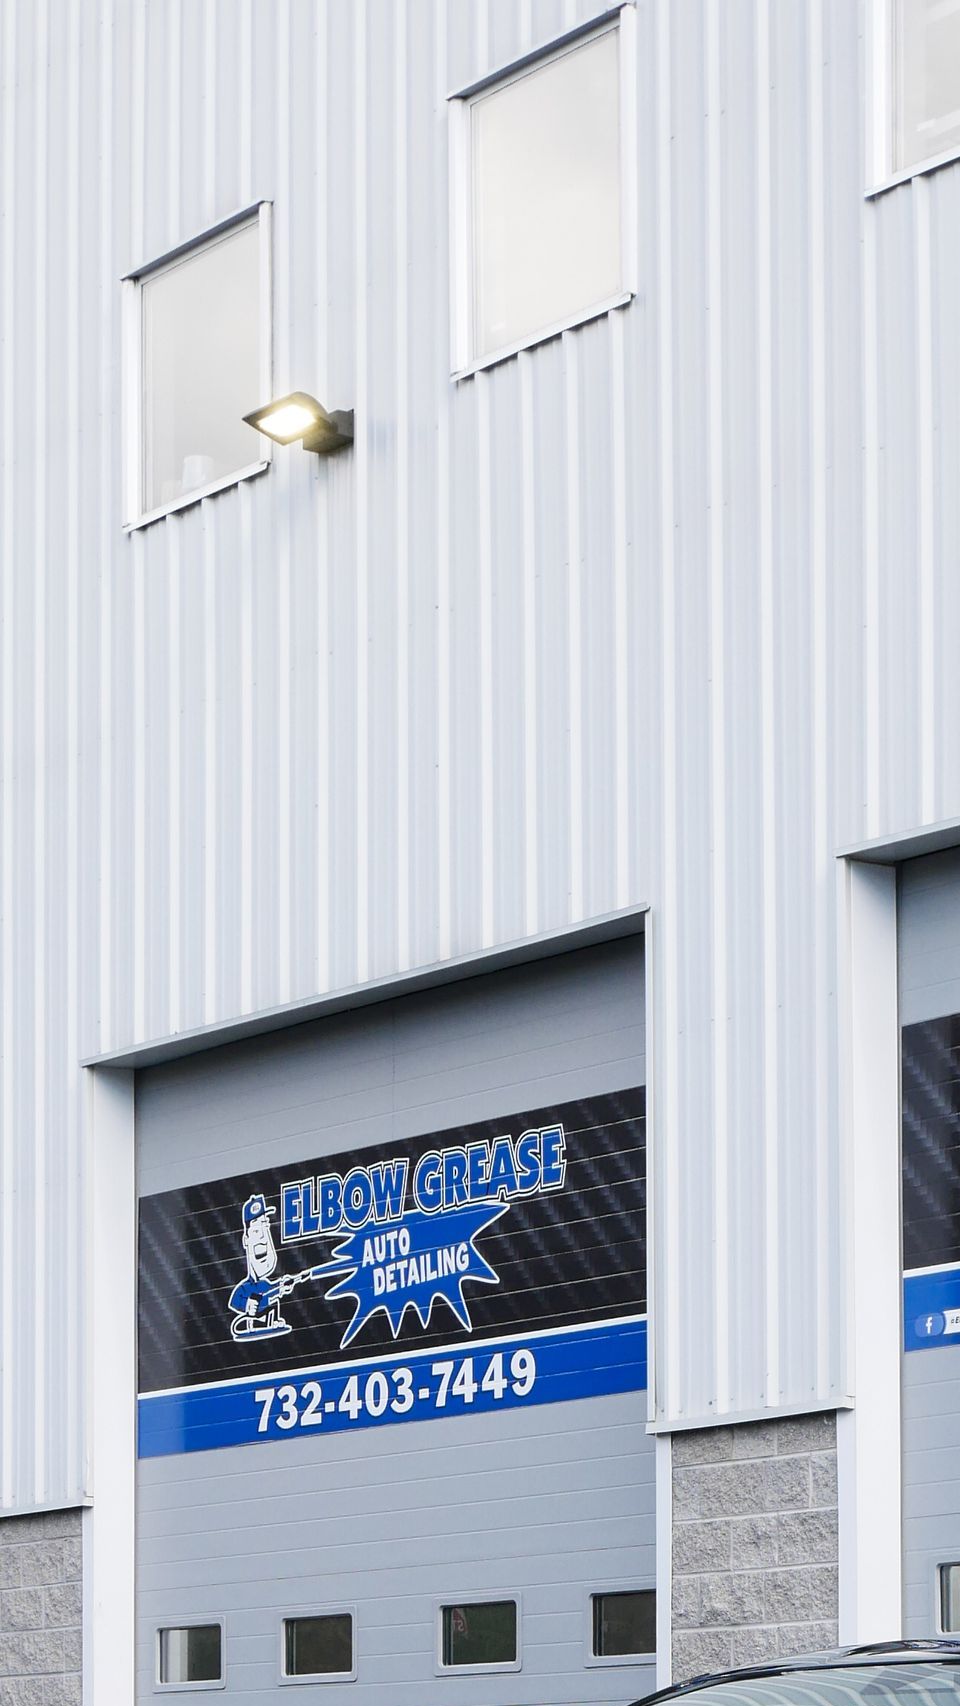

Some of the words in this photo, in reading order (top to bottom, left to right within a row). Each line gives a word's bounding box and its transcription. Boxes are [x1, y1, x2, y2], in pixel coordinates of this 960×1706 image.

[282, 1158, 409, 1243] ELBOW
[413, 1124, 566, 1212] GREASE
[362, 1227, 411, 1269] AUTO
[373, 1243, 470, 1296] DETAILING
[254, 1350, 537, 1433] 732-403-7449
